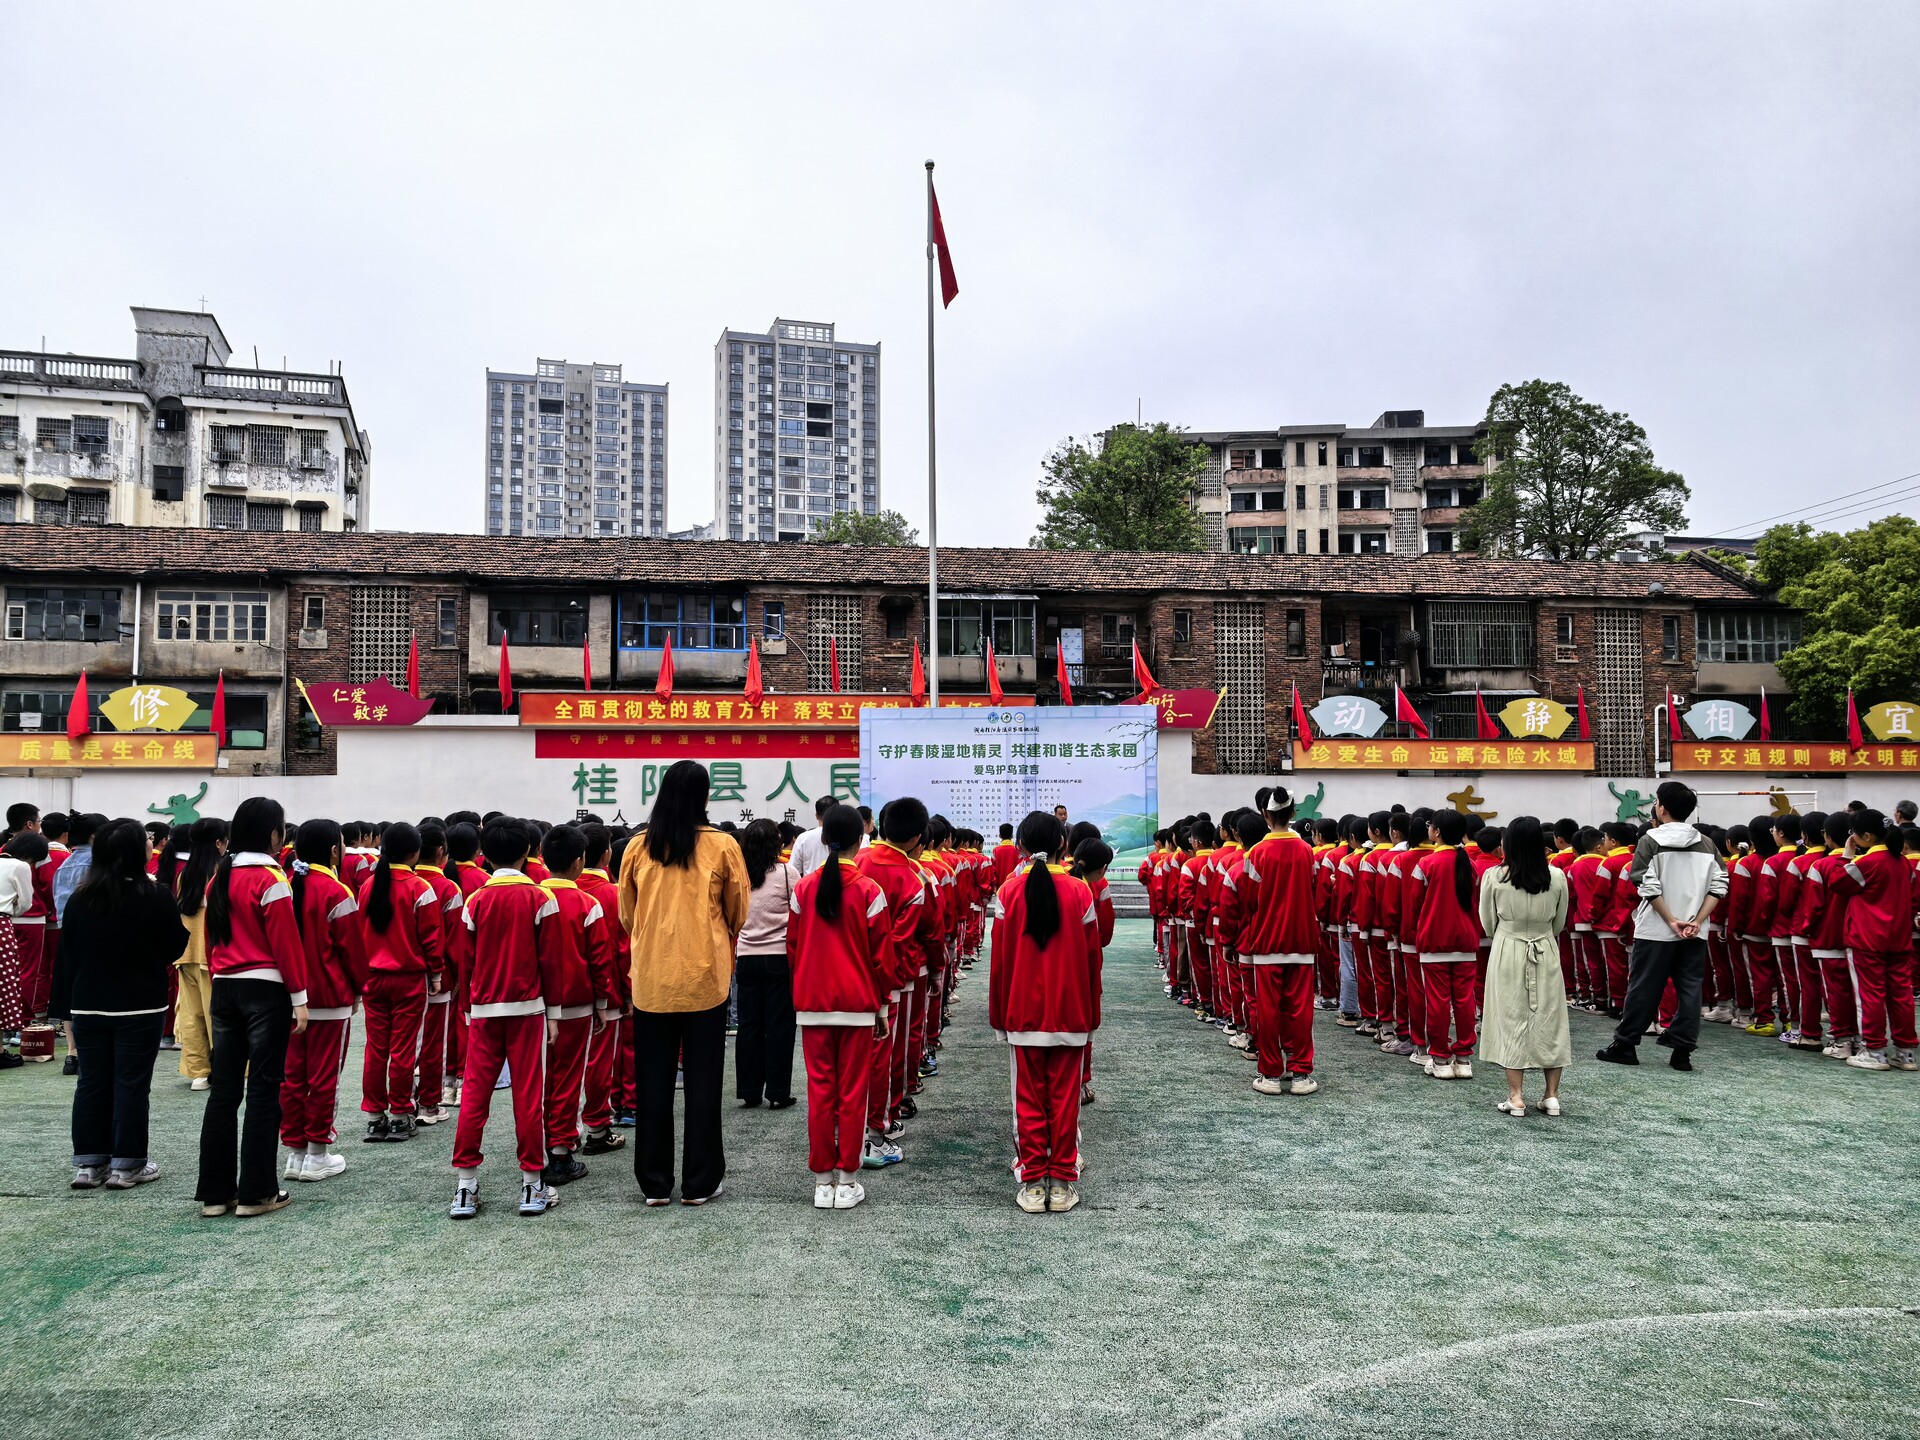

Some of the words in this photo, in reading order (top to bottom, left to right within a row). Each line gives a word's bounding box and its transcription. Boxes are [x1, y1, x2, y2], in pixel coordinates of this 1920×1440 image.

[332, 687, 367, 705] 仁爱
[129, 687, 170, 726] 修
[352, 704, 389, 722] 敏学
[554, 699, 779, 720] 全面贯彻党的教育方针
[1162, 709, 1193, 724] 合一
[1333, 701, 1366, 731] 动
[1521, 701, 1552, 733] 静
[1704, 703, 1734, 734] 相
[1885, 704, 1915, 735] 宜
[19, 740, 196, 761] 质量是生命线
[1010, 742, 1138, 759] 共建和谐生态家园
[1311, 745, 1410, 764] 珍爱生命
[1429, 746, 1578, 765] 远离危险水域
[1694, 748, 1811, 766] 守交通规则
[973, 764, 1040, 776] 爱鸟护鸟宣言
